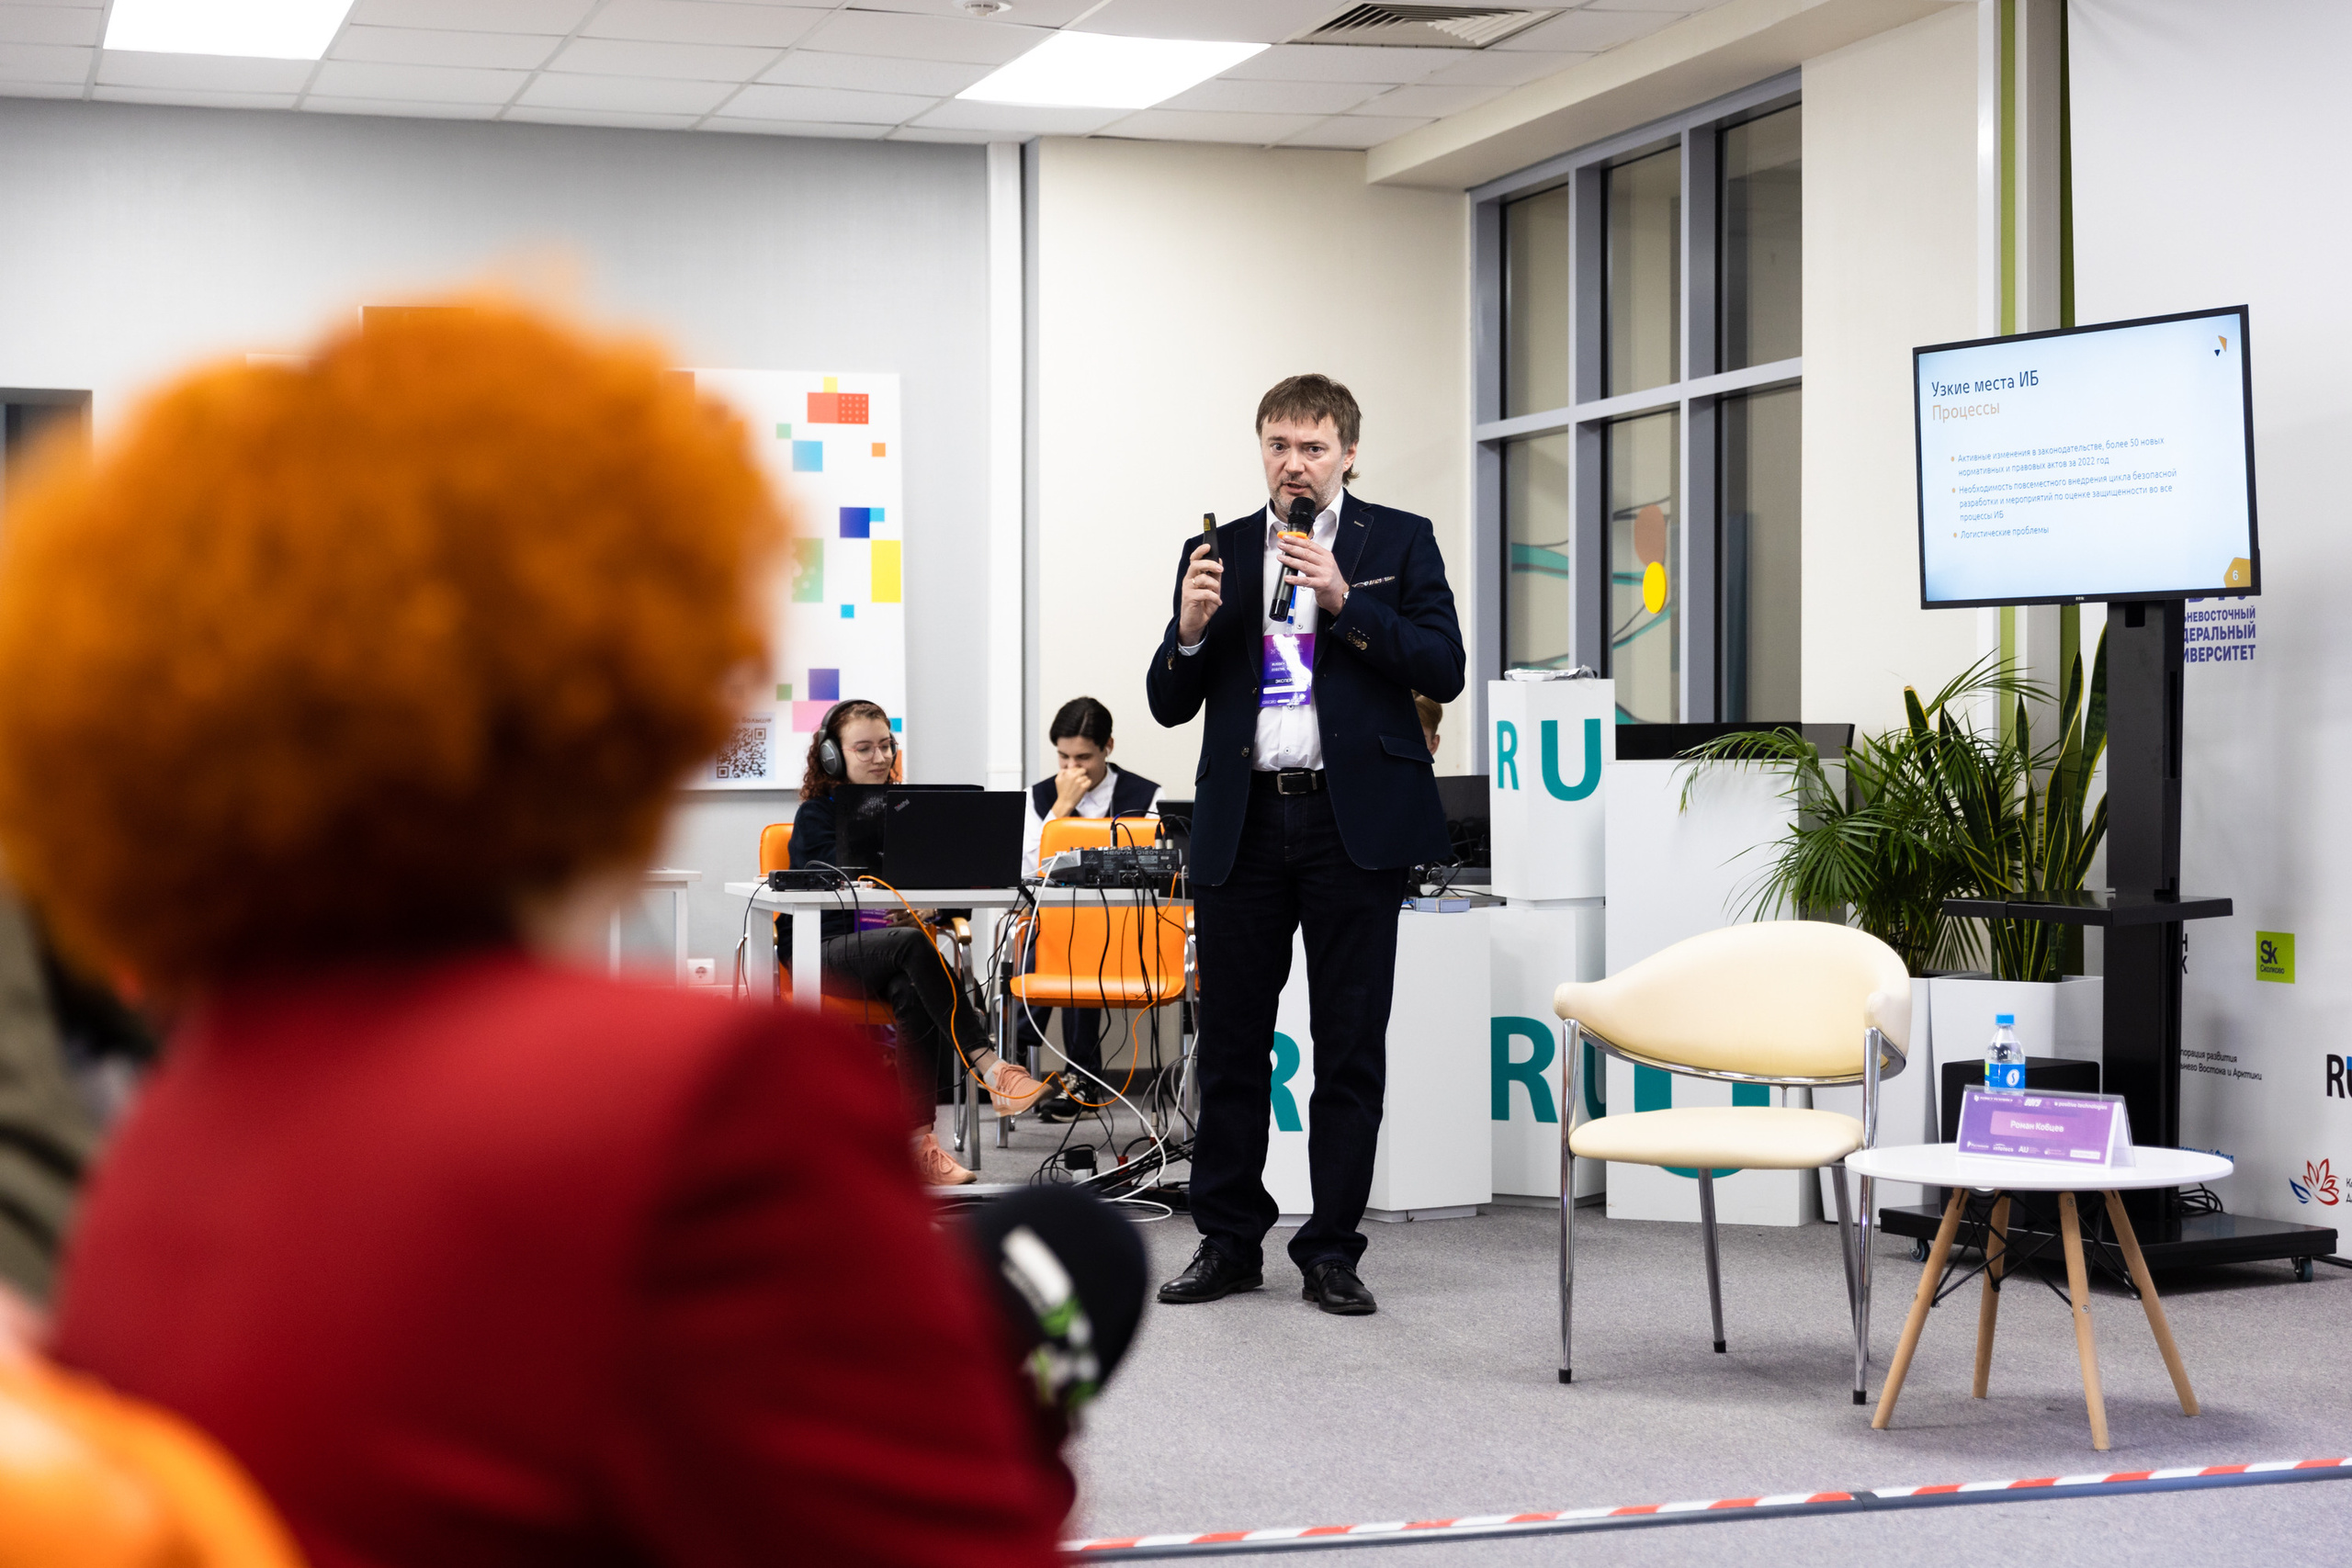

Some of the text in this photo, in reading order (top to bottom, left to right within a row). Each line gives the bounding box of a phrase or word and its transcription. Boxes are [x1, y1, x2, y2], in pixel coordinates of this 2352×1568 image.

[1931, 369, 2040, 398] Узкие места ИБ
[1932, 402, 2000, 423] Процессы
[1958, 453, 1992, 462] Активные
[1993, 449, 2031, 459] изменения
[2038, 443, 2105, 457] законодательстве,
[2106, 439, 2129, 449] более
[2130, 437, 2140, 447] 50
[2141, 437, 2165, 446] новых
[1958, 466, 2005, 478] нормативных
[2012, 462, 2046, 473] правовых
[2047, 460, 2067, 469] актов
[2069, 459, 2076, 468] за
[2077, 457, 2095, 467] 2022
[2096, 457, 2109, 465] год
[1959, 468, 2177, 494] Необходимость повсеместного внедрения цикла безопасной
[1960, 497, 1998, 509] разработки
[2006, 491, 2053, 505] мероприятий
[2064, 491, 2091, 502] оценке
[2092, 487, 2148, 498] защищенности
[2160, 484, 2173, 492] все
[1960, 510, 2004, 523] процессы ИБ
[1961, 525, 2050, 539] Логистические проблемы
[2232, 570, 2239, 581] 6
[1497, 720, 1520, 791] R
[1541, 718, 1601, 801] U
[2206, 1051, 2237, 1064] развития
[1490, 1016, 1559, 1123] R
[2199, 1063, 2226, 1077] Востока
[2233, 1068, 2263, 1081] Арктики
[2010, 1120, 2064, 1134] Роман Кобцев
